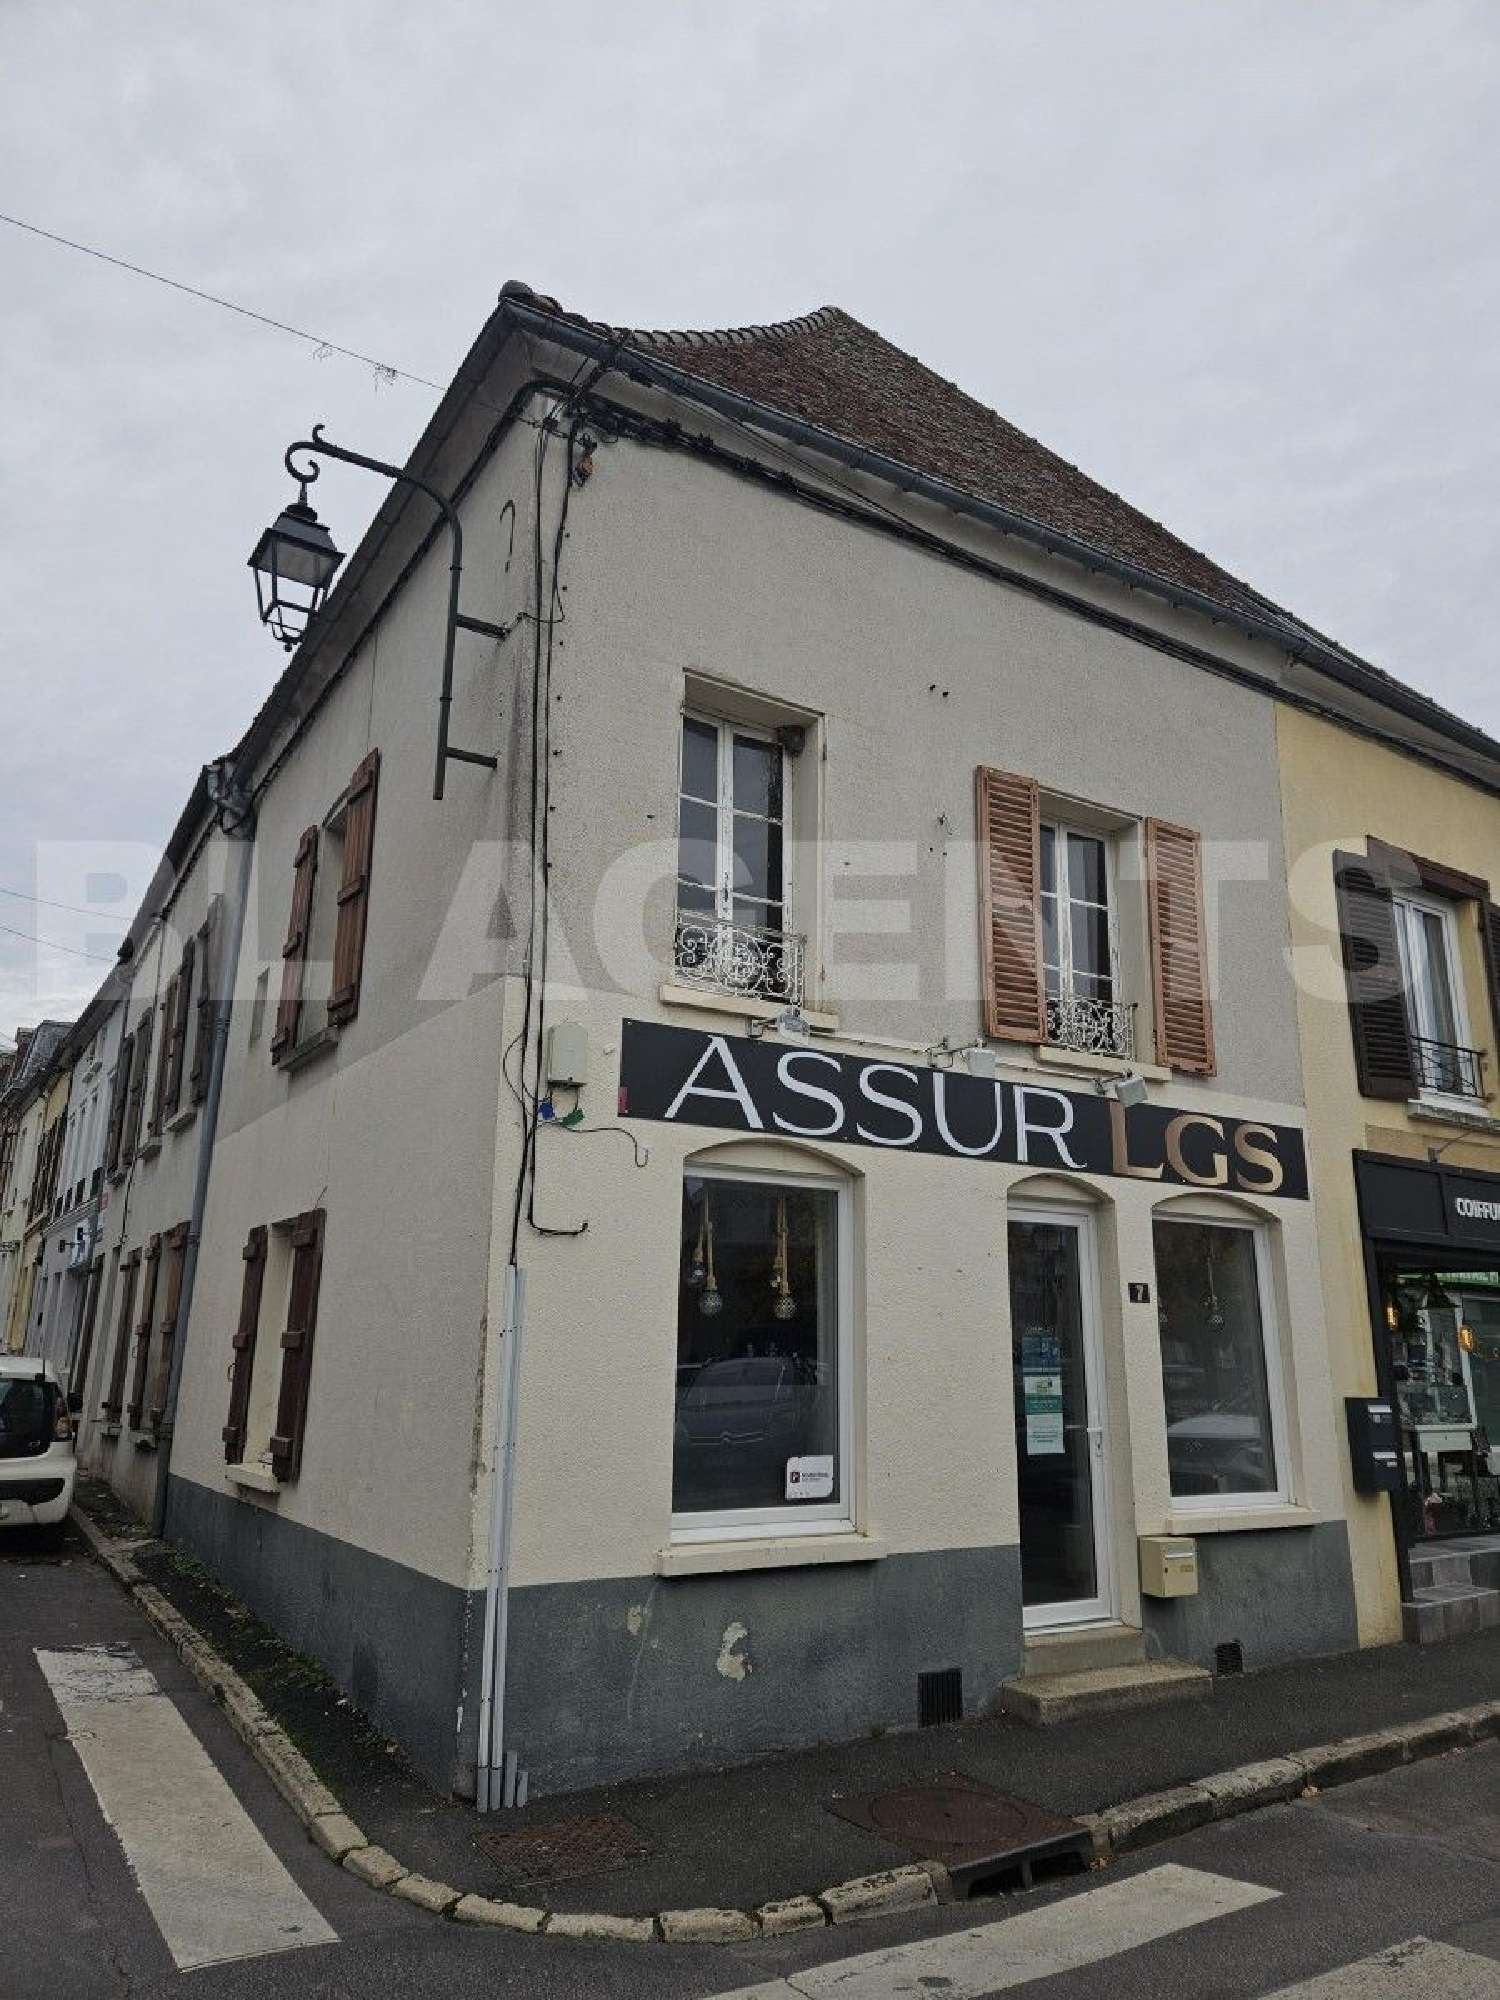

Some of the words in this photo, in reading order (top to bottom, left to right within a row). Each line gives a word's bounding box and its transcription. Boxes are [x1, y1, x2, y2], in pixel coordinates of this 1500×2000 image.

[664, 1035, 1087, 1169] ASSUR
[1109, 1100, 1285, 1193] LGS
[1455, 1197, 1500, 1221] COIFFU
